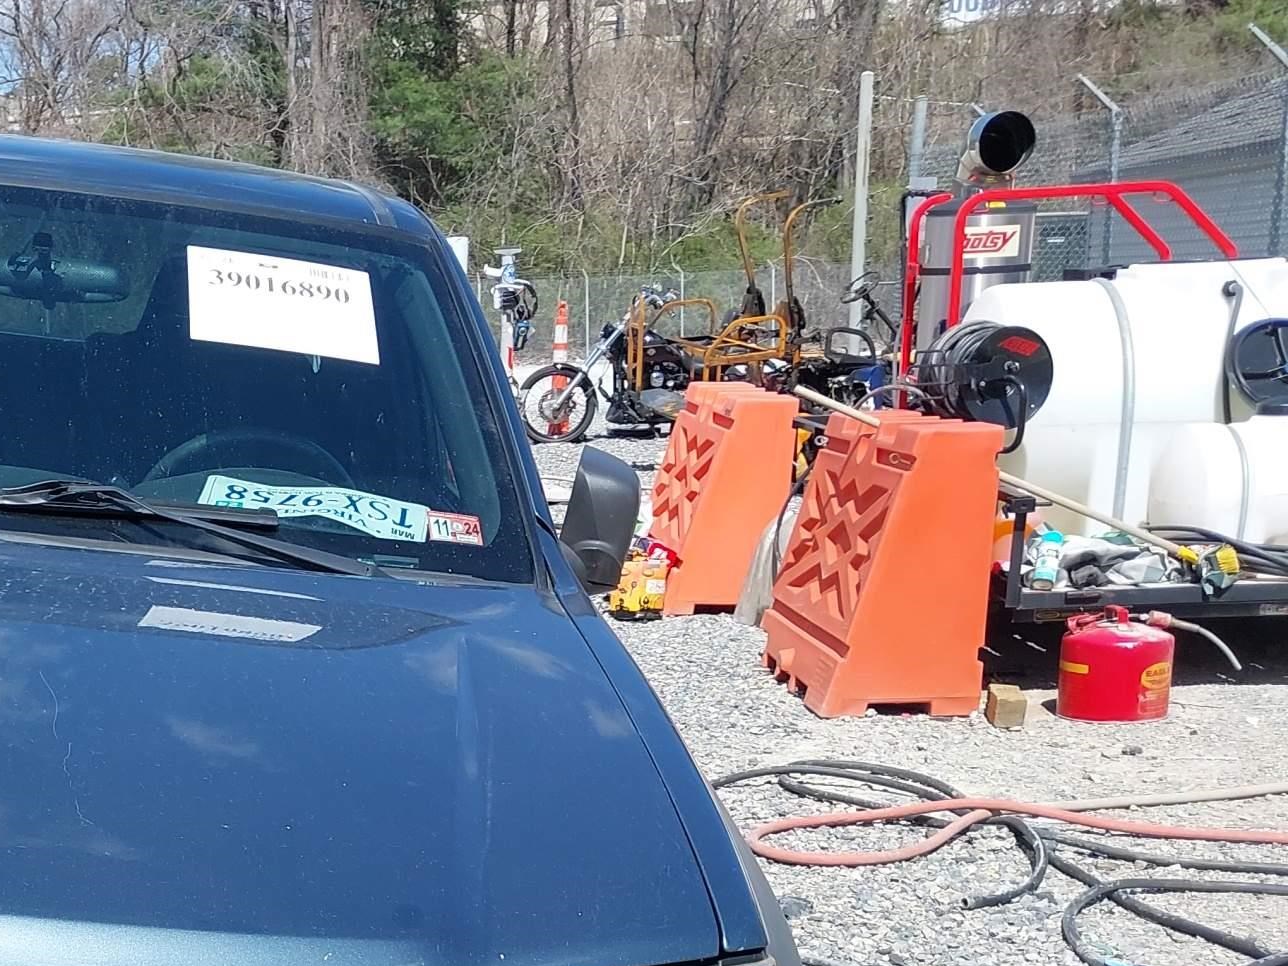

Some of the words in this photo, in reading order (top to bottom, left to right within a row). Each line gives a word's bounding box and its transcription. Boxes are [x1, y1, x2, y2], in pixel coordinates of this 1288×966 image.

[963, 230, 1017, 253] otsy
[209, 269, 350, 304] 39016890
[225, 484, 414, 529] TSX-9758
[277, 507, 368, 529] VIRGINI
[433, 519, 450, 537] 11
[464, 522, 480, 536] 24
